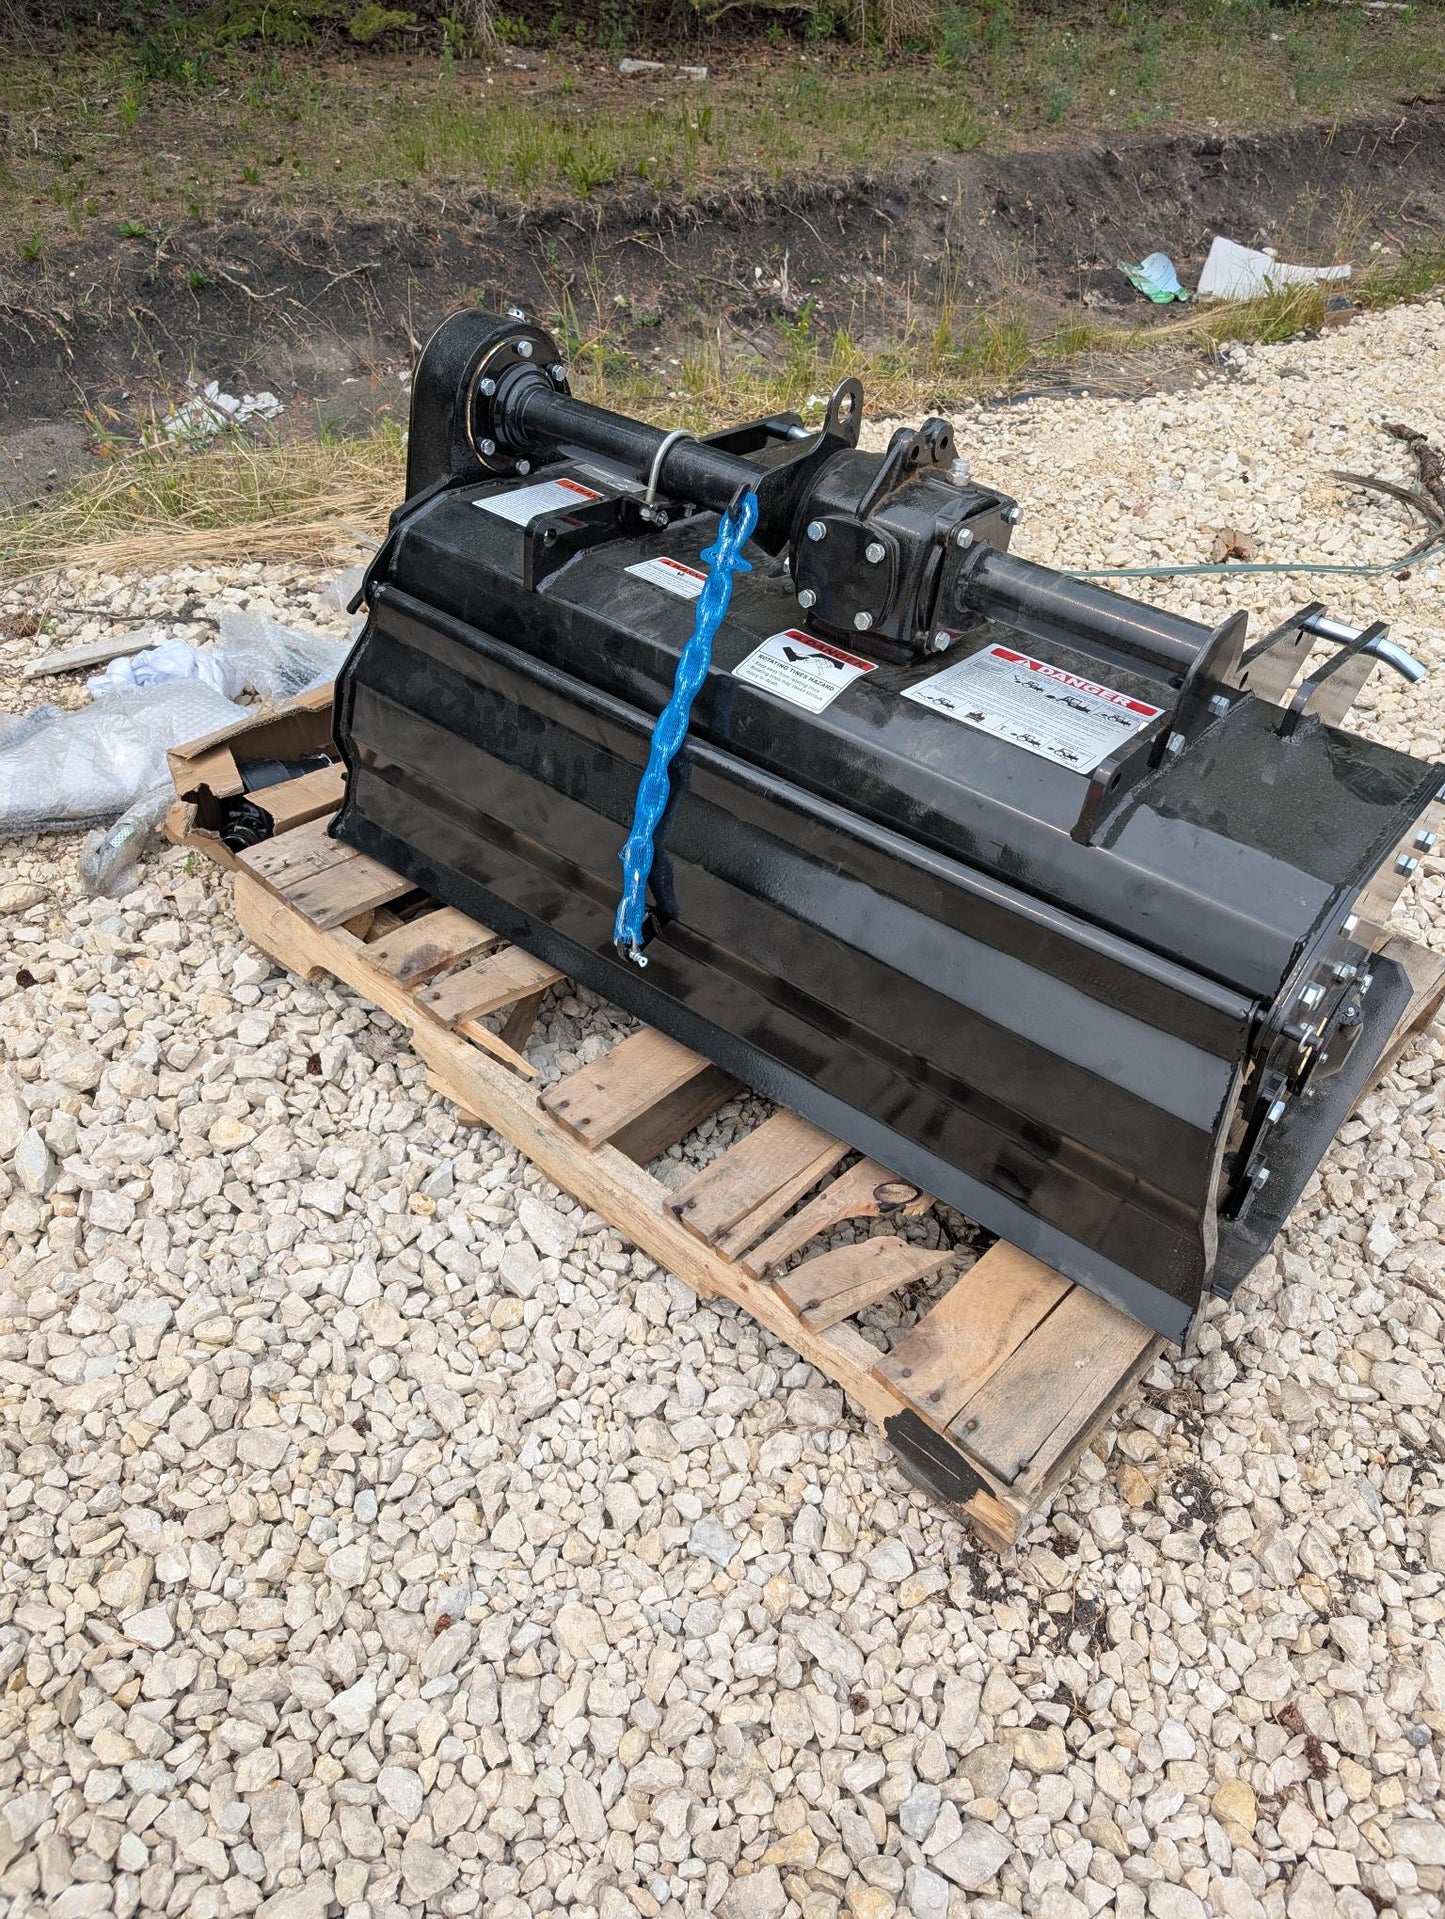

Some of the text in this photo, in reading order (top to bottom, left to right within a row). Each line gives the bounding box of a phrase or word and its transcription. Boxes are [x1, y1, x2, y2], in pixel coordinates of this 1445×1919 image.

[758, 654, 835, 691] ROTATING TINES HAZARD
[807, 639, 868, 669] DANGER
[1036, 665, 1131, 708] DANGER
